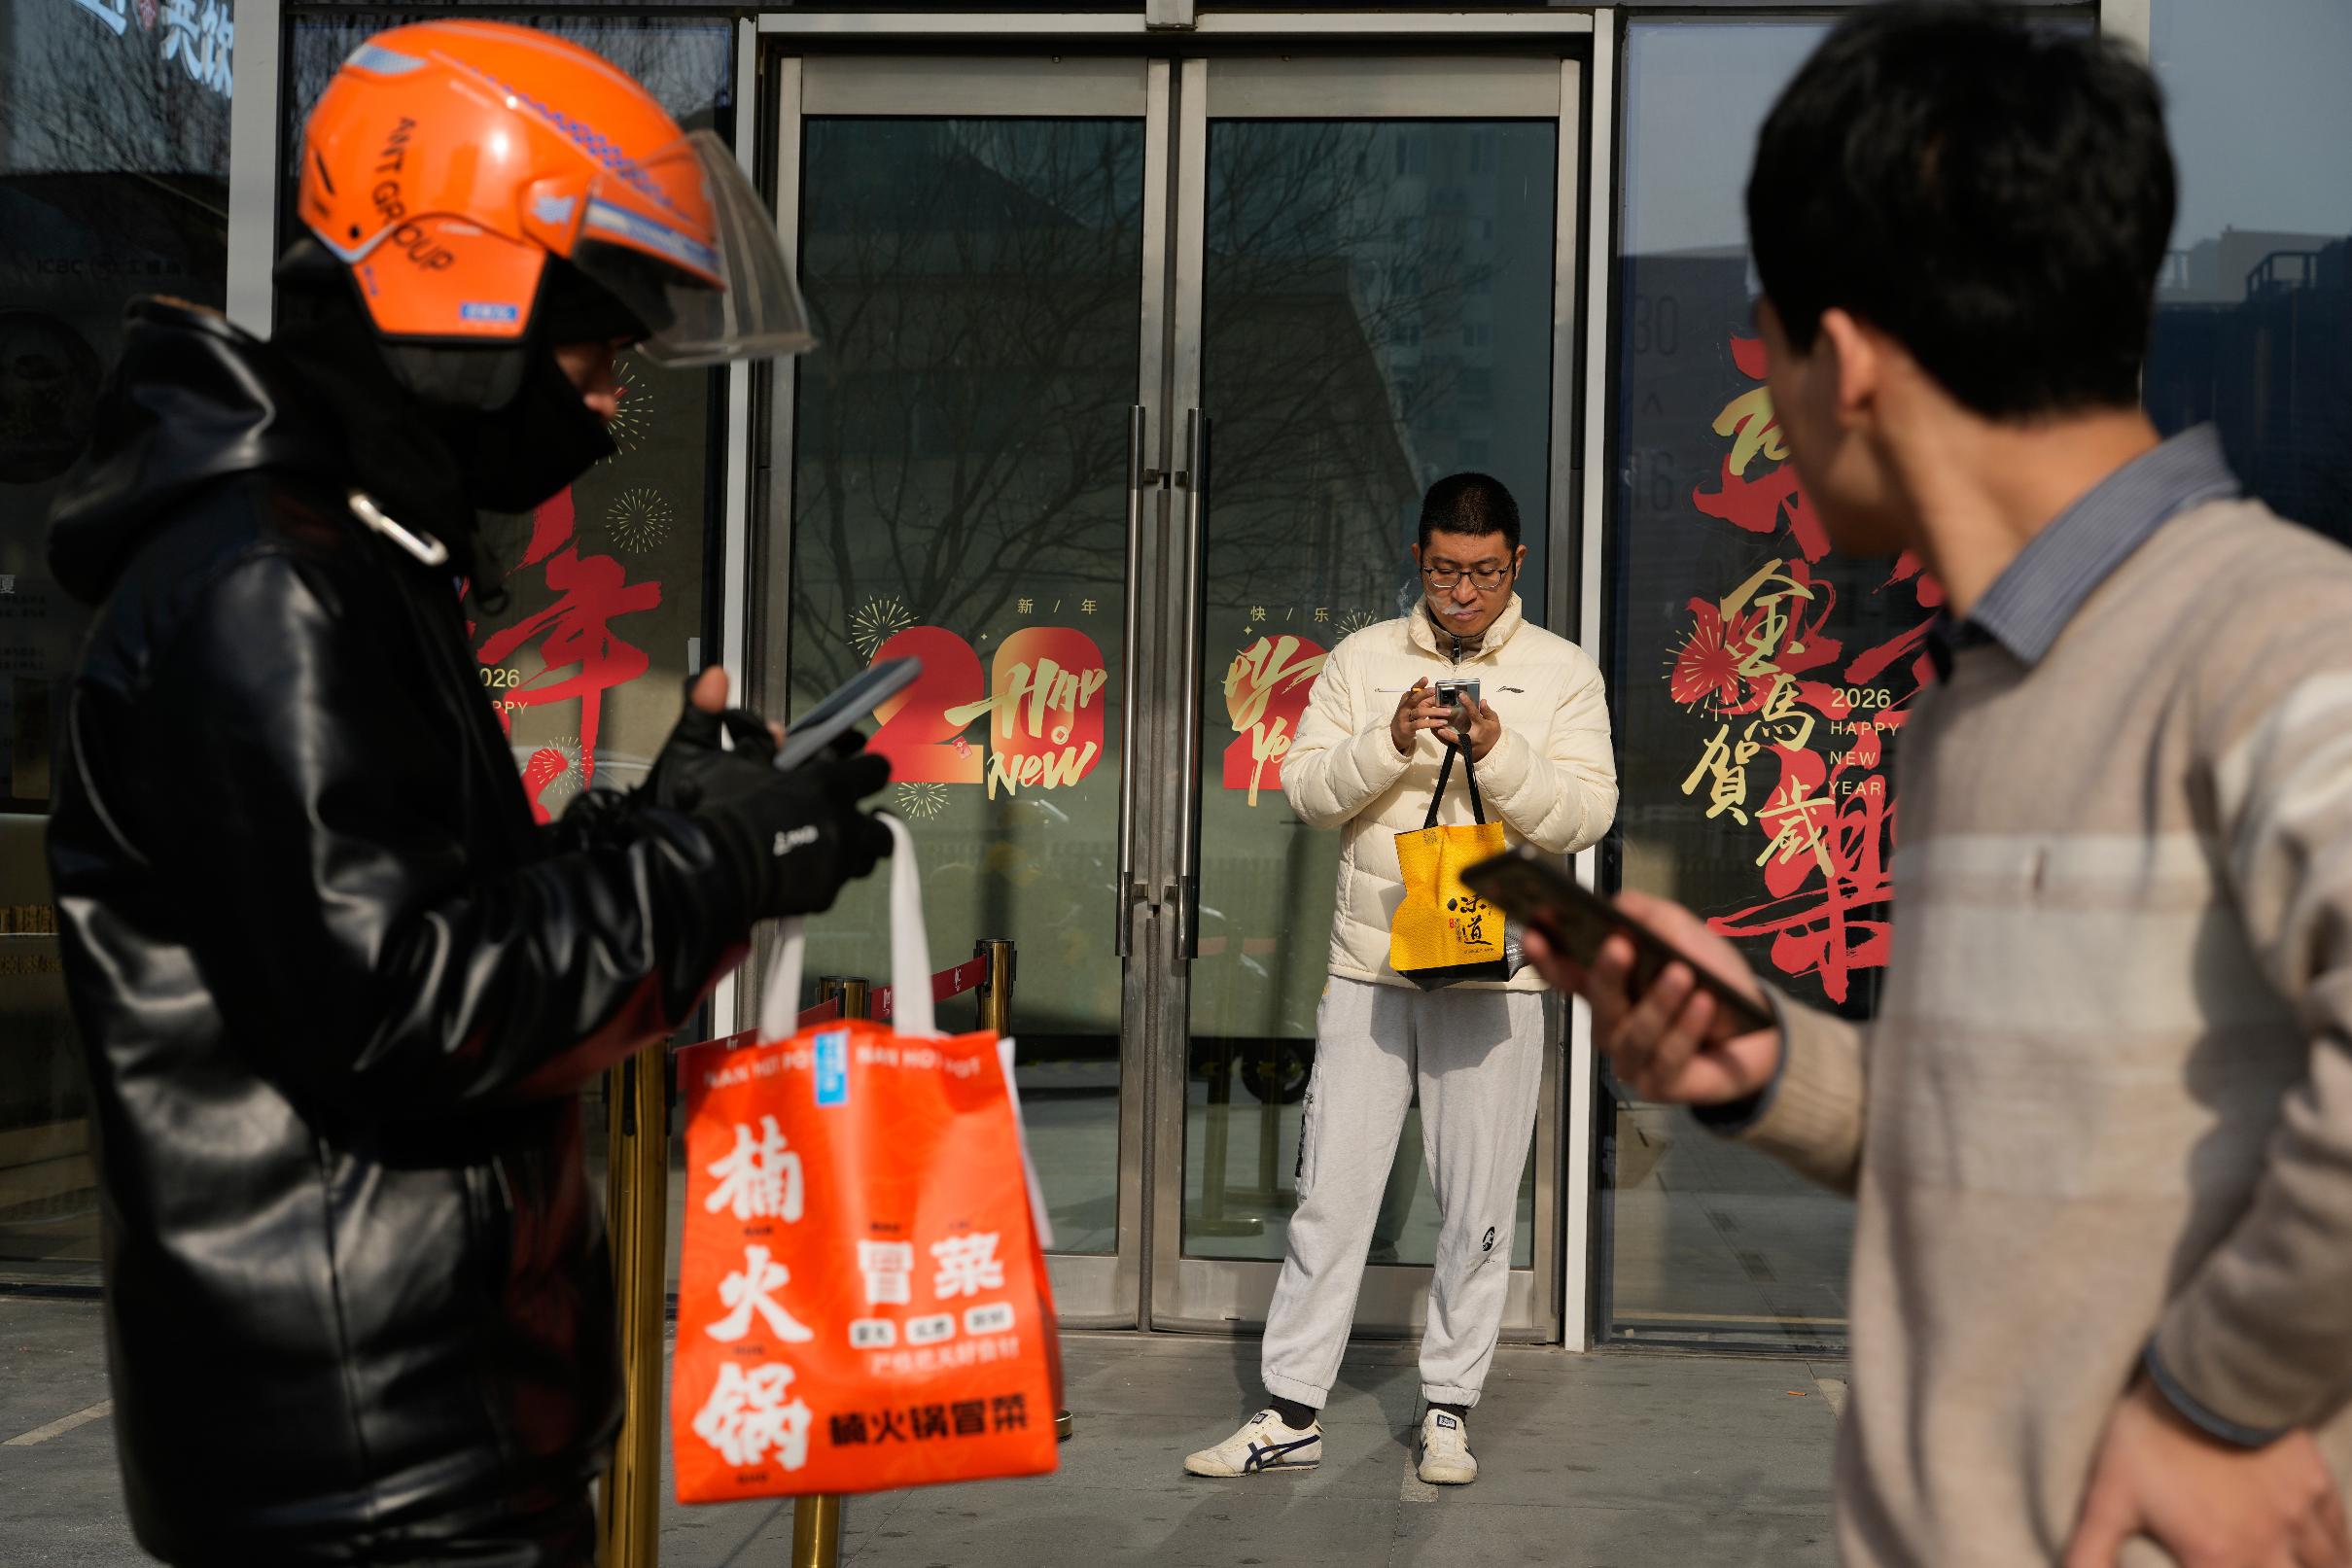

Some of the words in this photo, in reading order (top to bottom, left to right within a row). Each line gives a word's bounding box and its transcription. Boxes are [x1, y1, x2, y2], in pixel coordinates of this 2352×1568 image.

[371, 180, 455, 271] GROUP
[1017, 598, 1034, 614] 新
[1080, 598, 1098, 614] 年
[1250, 606, 1266, 622] 快
[1314, 607, 1329, 623] 乐
[479, 667, 521, 688] 026
[491, 700, 528, 714] PPY
[1830, 688, 1891, 710] 2026
[1830, 721, 1900, 737] HAPPY
[1246, 715, 1292, 808] Ye
[1830, 750, 1877, 766] NEW
[1828, 781, 1882, 796] YEAR
[857, 1231, 1005, 1306] 冒菜
[692, 1114, 814, 1472] 楠火锅
